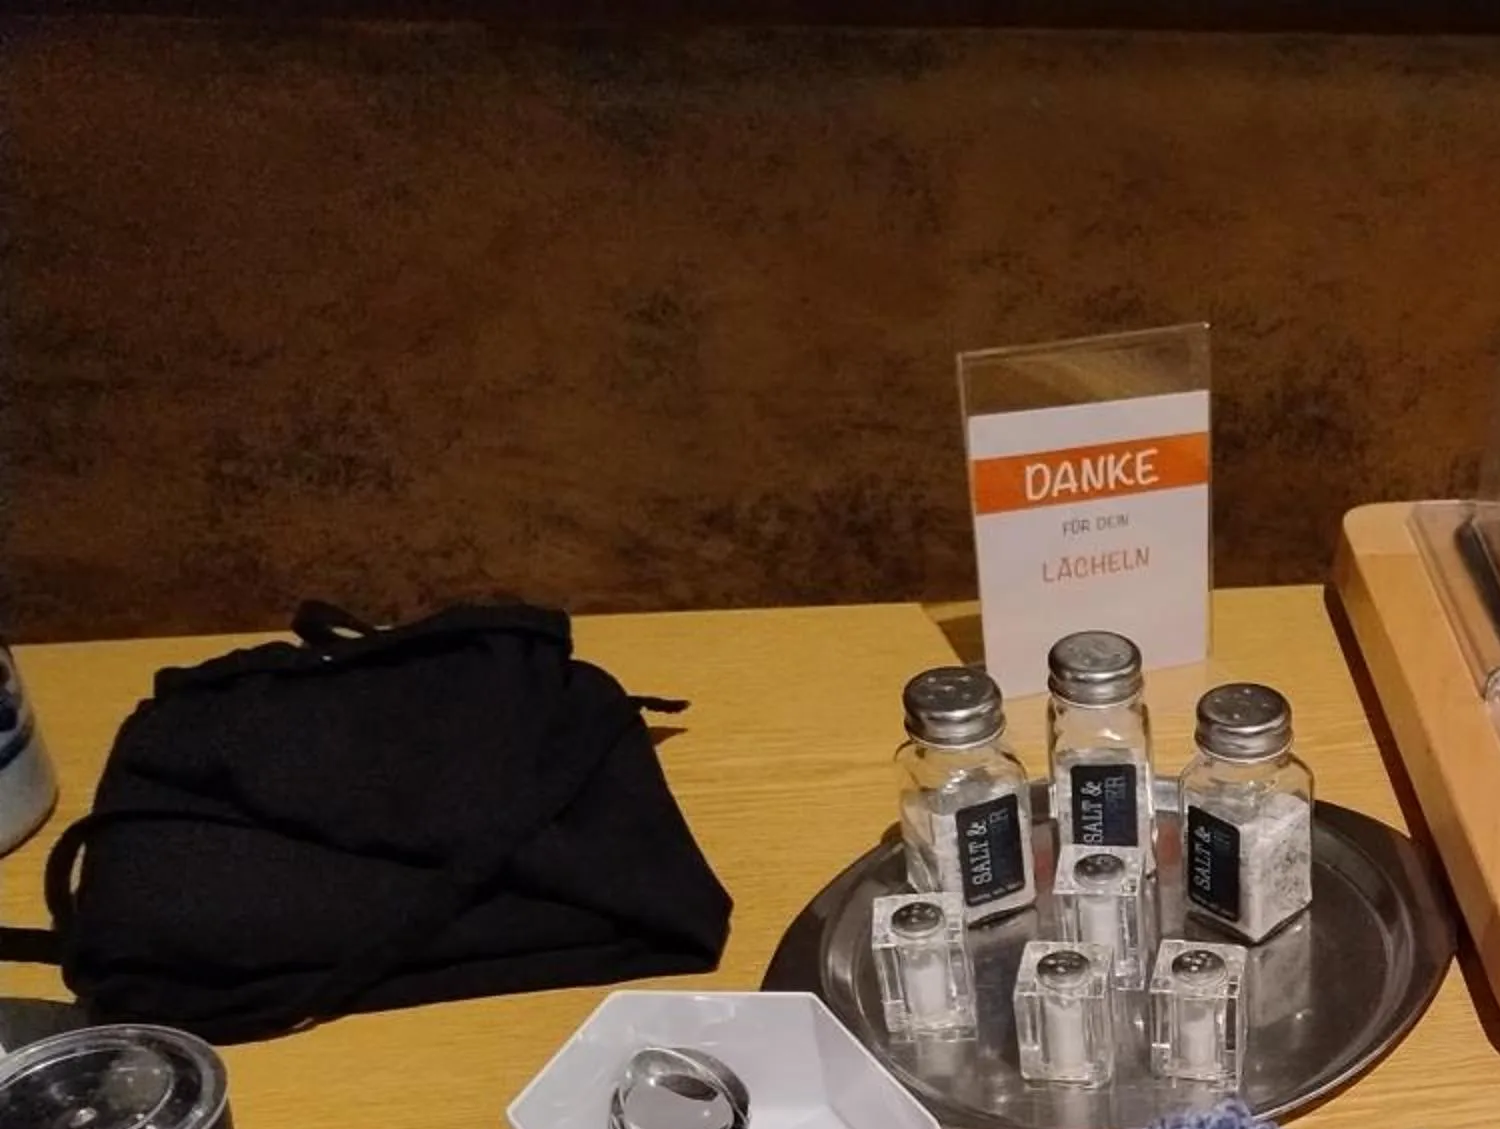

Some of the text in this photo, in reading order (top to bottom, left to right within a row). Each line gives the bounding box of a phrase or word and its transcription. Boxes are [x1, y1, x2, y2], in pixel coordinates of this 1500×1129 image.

[1024, 447, 1160, 501] DANKE
[1096, 513, 1129, 531] DEIN
[1042, 546, 1150, 583] LÄCHELN
[1080, 781, 1104, 845] SALT &
[965, 819, 993, 885] SALT &
[1193, 825, 1211, 892] SALT &
